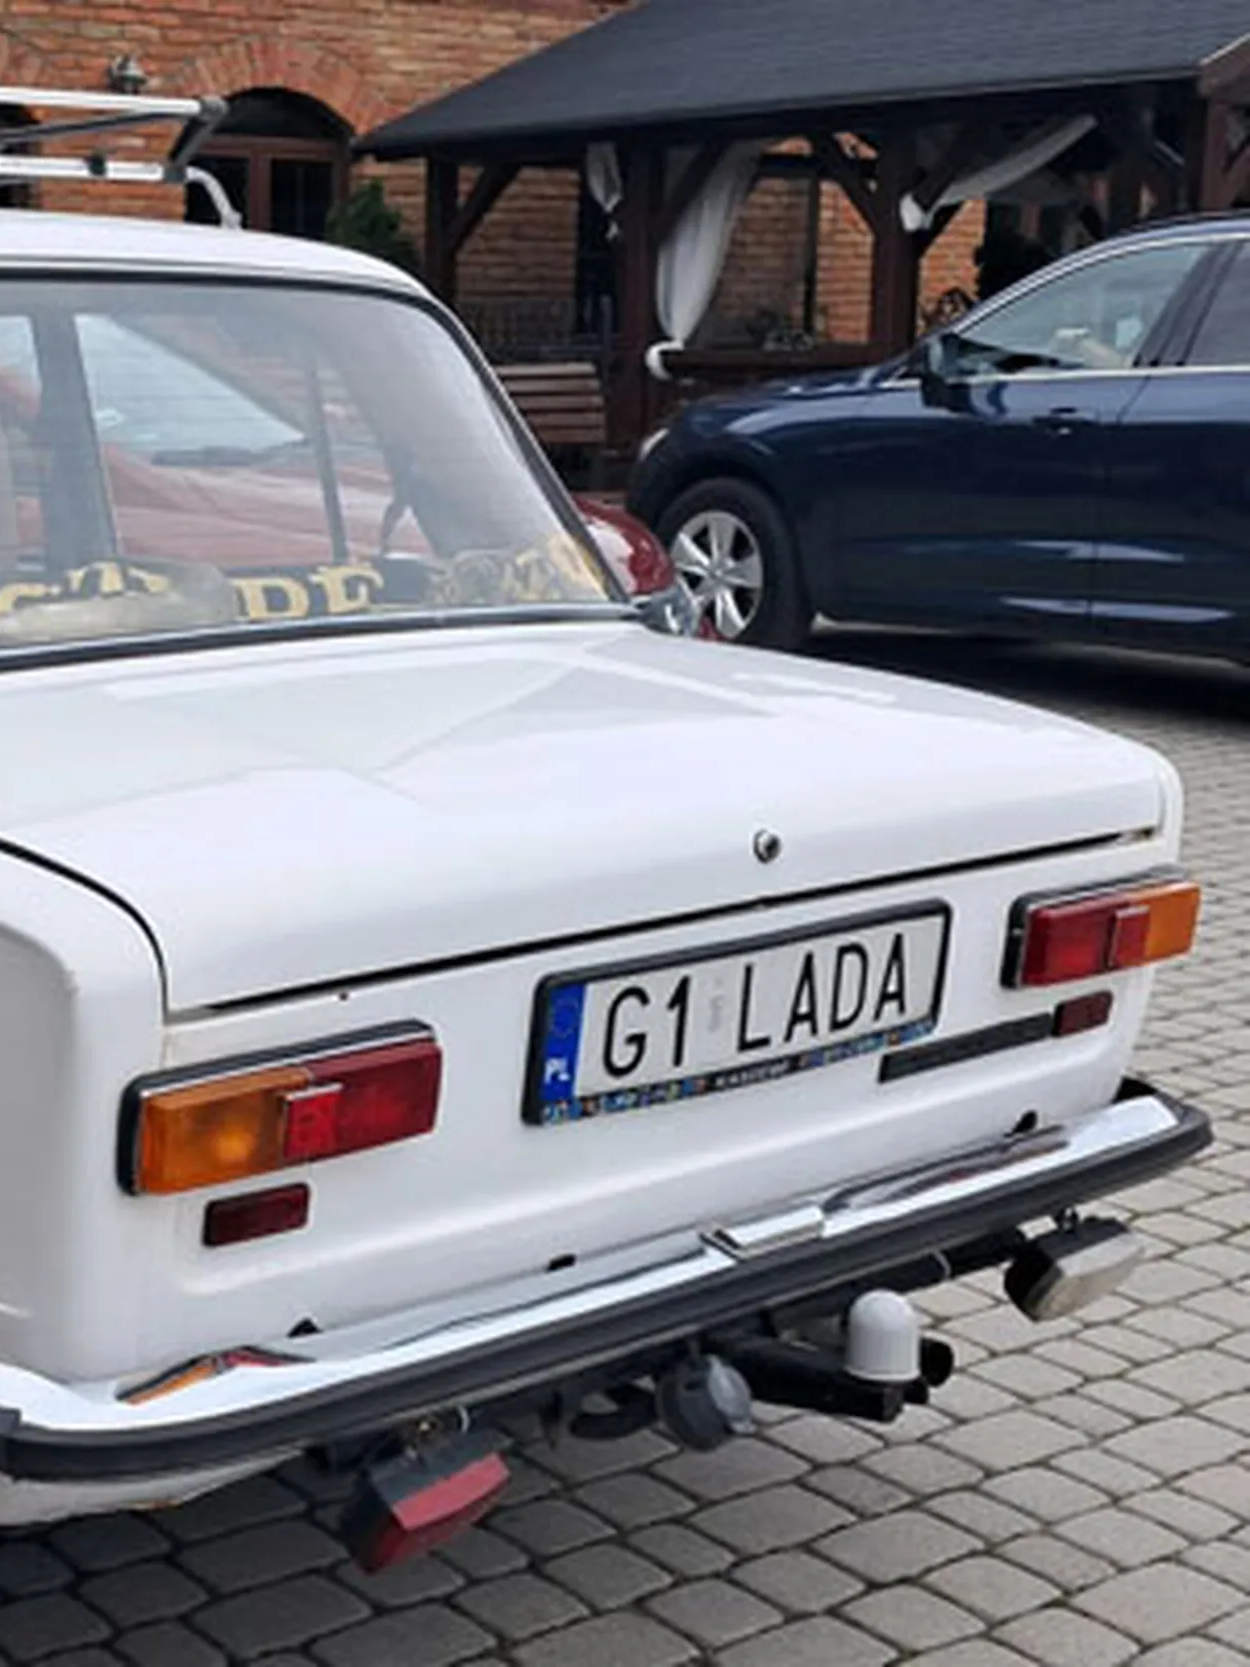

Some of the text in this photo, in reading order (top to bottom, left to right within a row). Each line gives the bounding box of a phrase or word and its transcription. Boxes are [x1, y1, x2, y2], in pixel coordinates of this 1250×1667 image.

[603, 932, 906, 1078] G1 LADA
[544, 1057, 570, 1084] PL
